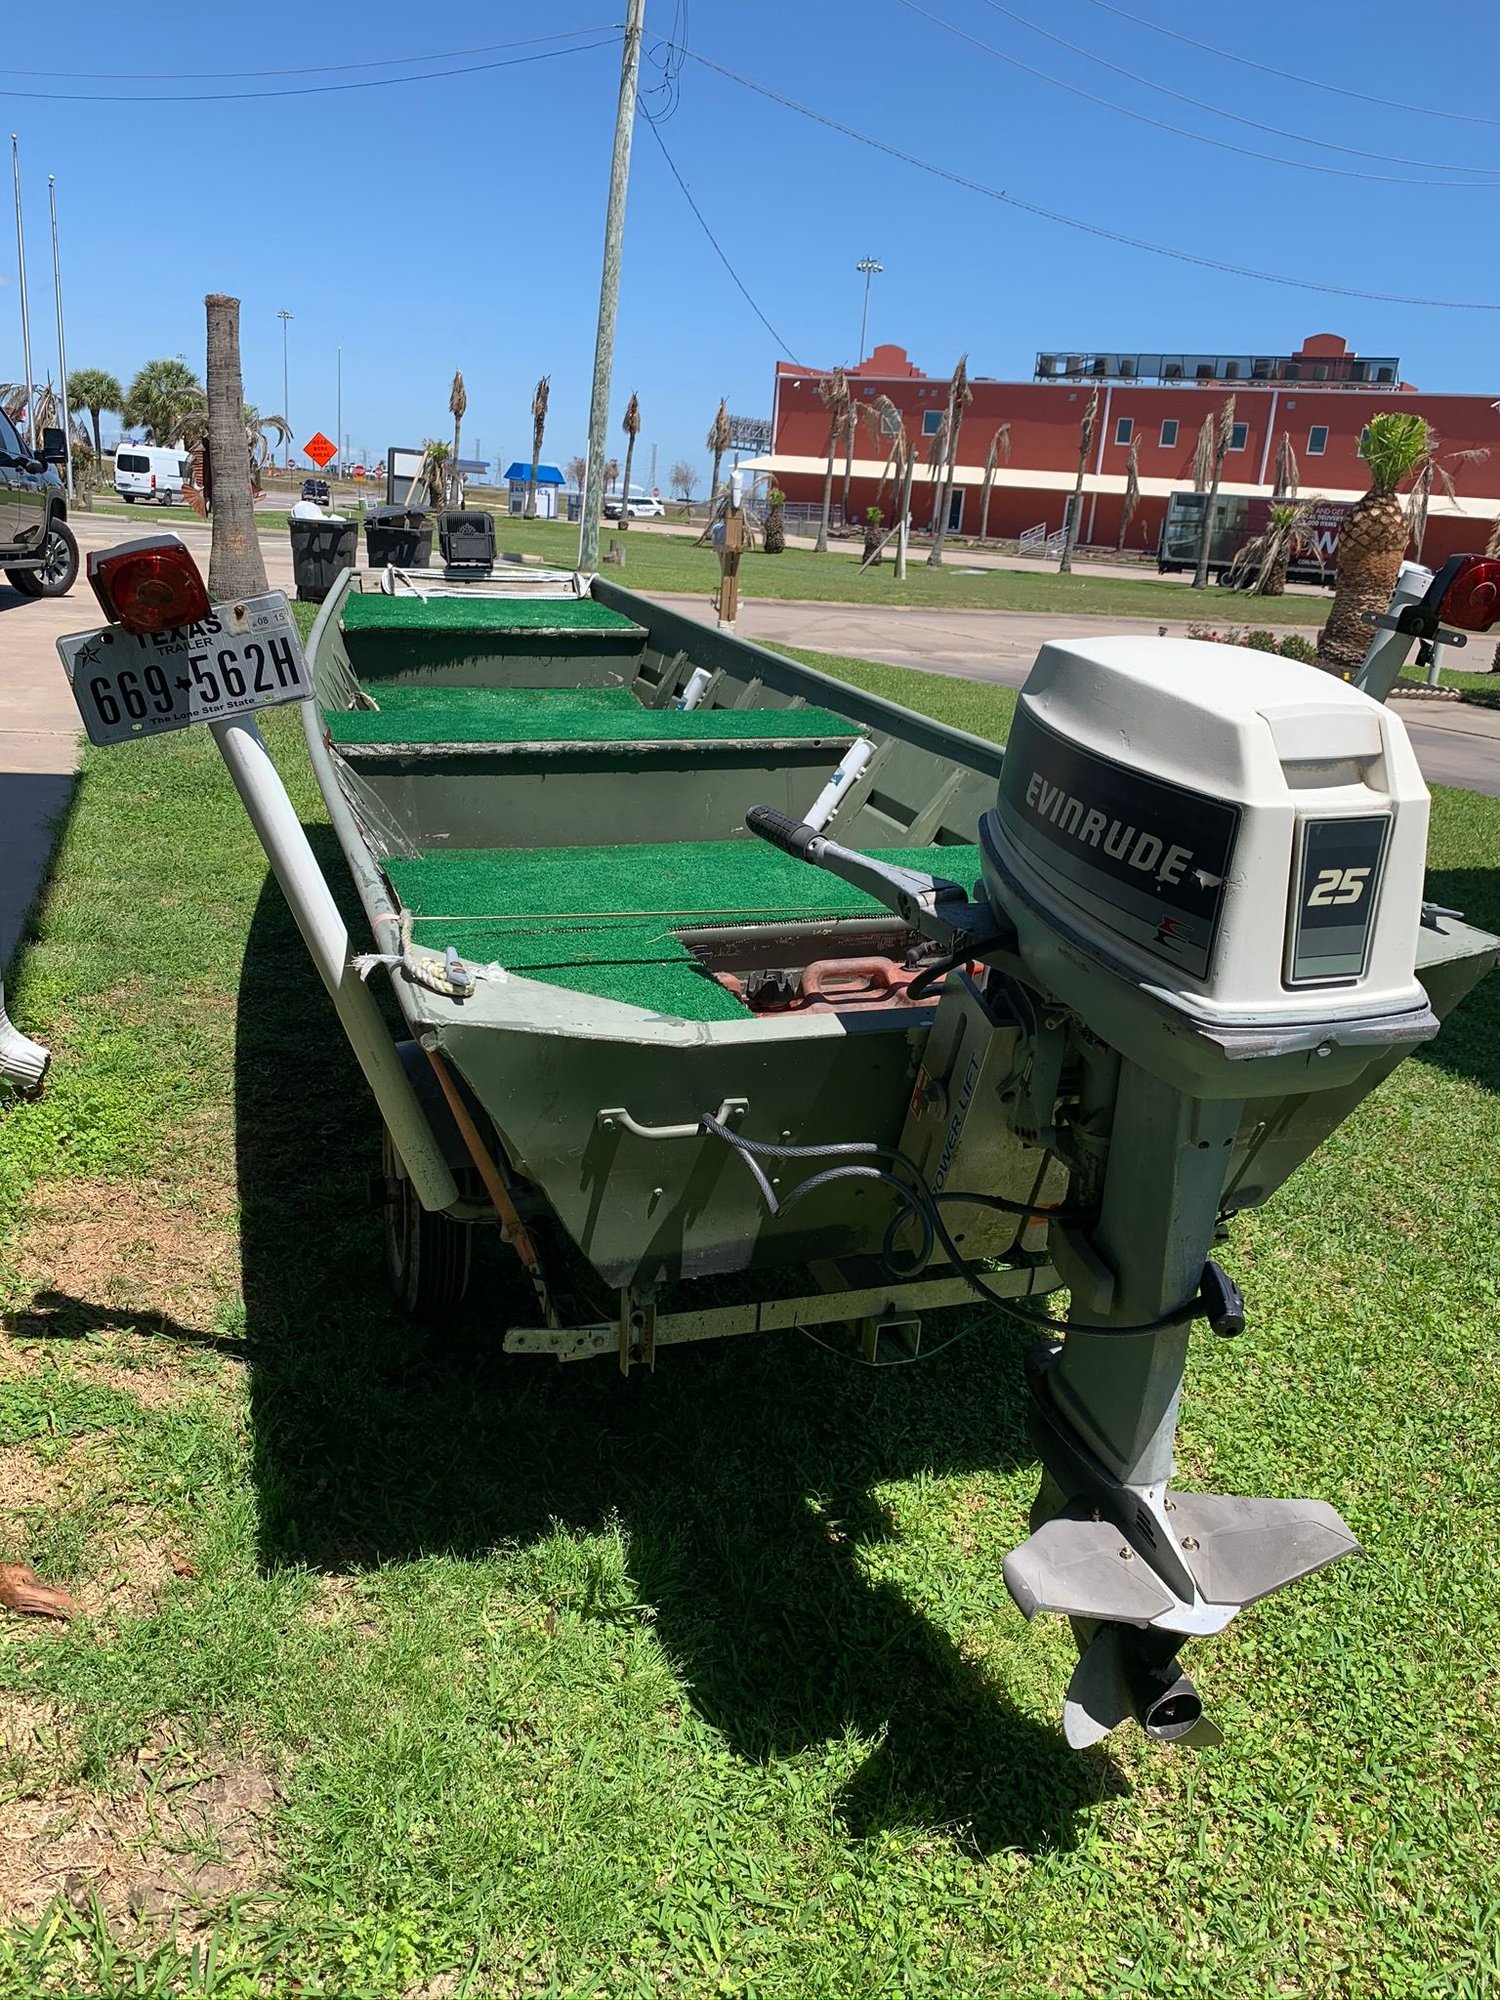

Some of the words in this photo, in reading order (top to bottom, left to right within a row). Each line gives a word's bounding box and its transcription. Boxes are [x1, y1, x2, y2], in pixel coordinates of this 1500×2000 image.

[1315, 507, 1331, 515] AND
[1331, 508, 1345, 516] GET
[257, 616, 269, 625] 08
[274, 612, 285, 621] 15
[156, 637, 214, 656] TRAILER
[89, 665, 174, 725] 669
[188, 636, 301, 703] 562H
[150, 714, 171, 725] The
[172, 709, 200, 722] Lone
[202, 703, 225, 715] Star
[226, 696, 256, 710] State
[1025, 771, 1194, 885] EVINRUDE
[1306, 866, 1372, 907] 25
[931, 1113, 962, 1195] POWER
[958, 1051, 979, 1110] LIFT
